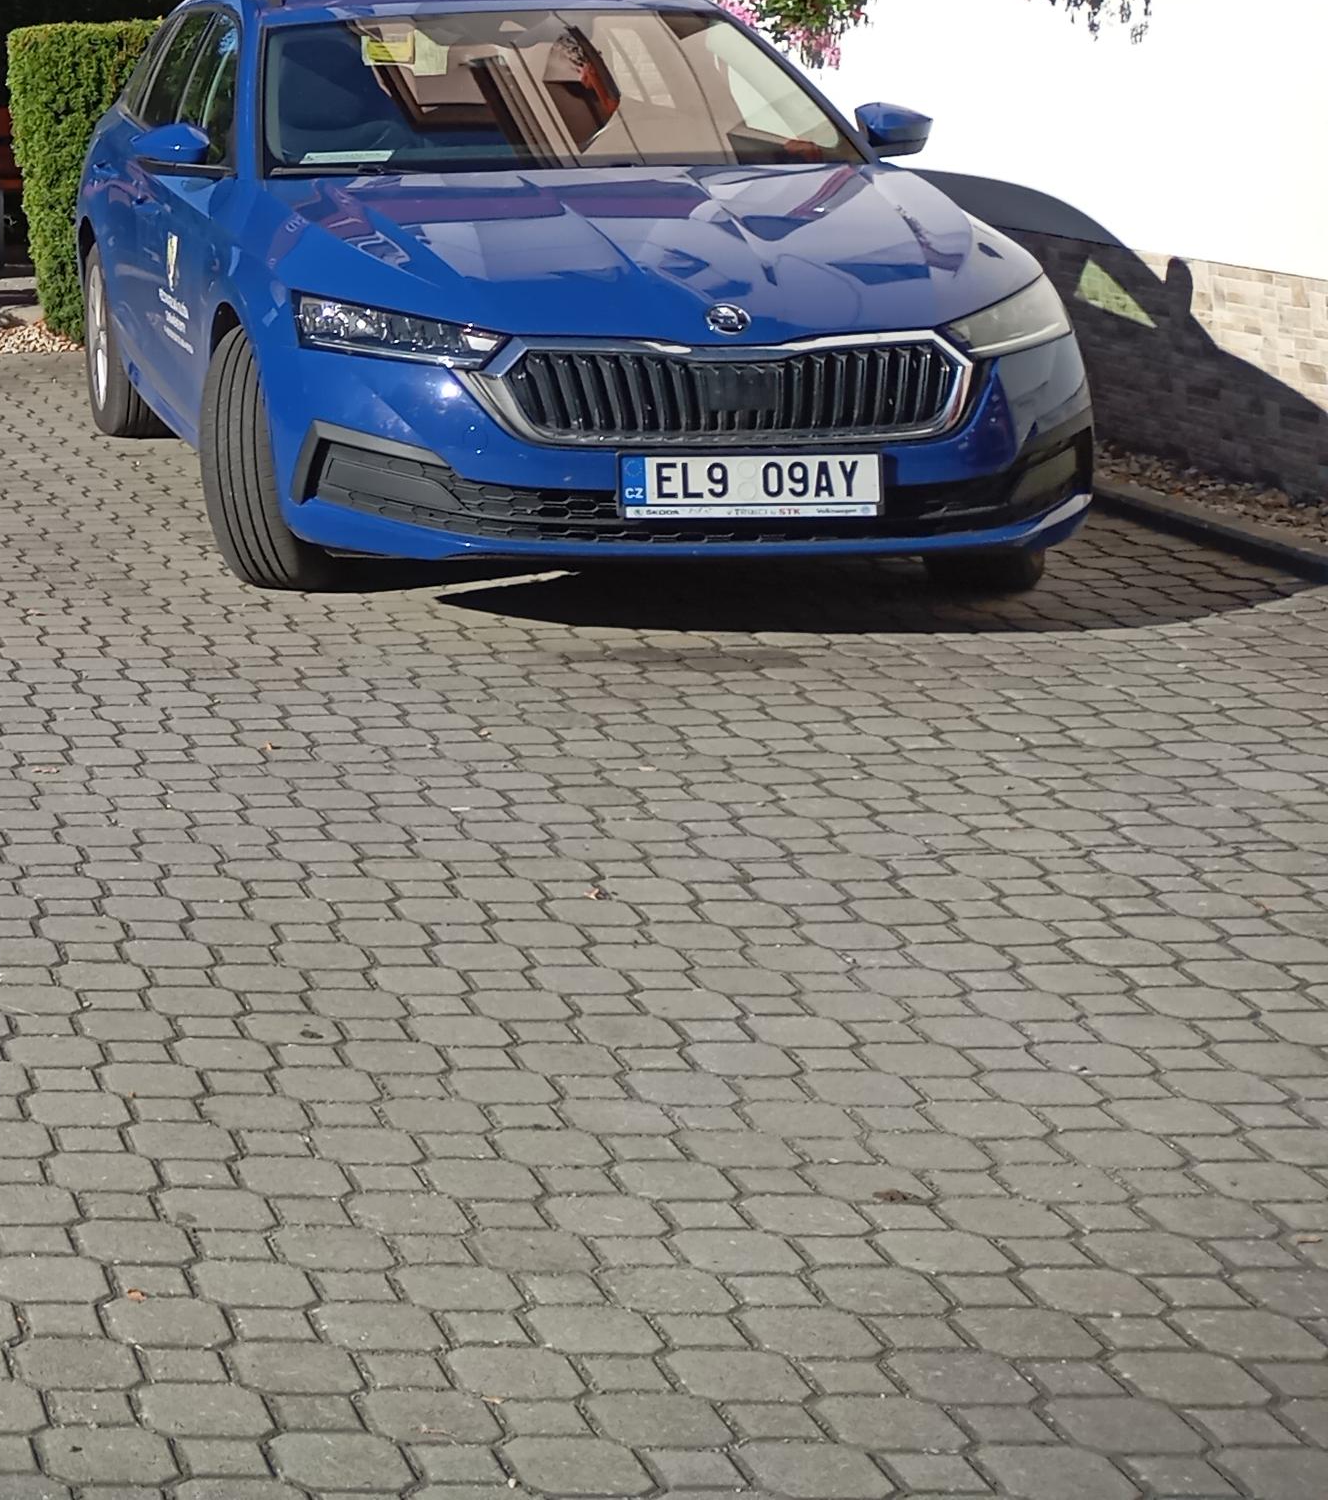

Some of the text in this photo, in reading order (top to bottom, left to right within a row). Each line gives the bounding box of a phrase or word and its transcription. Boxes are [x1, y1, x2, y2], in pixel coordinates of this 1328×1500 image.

[655, 460, 858, 499] EL9 09AY
[625, 487, 644, 499] CZ
